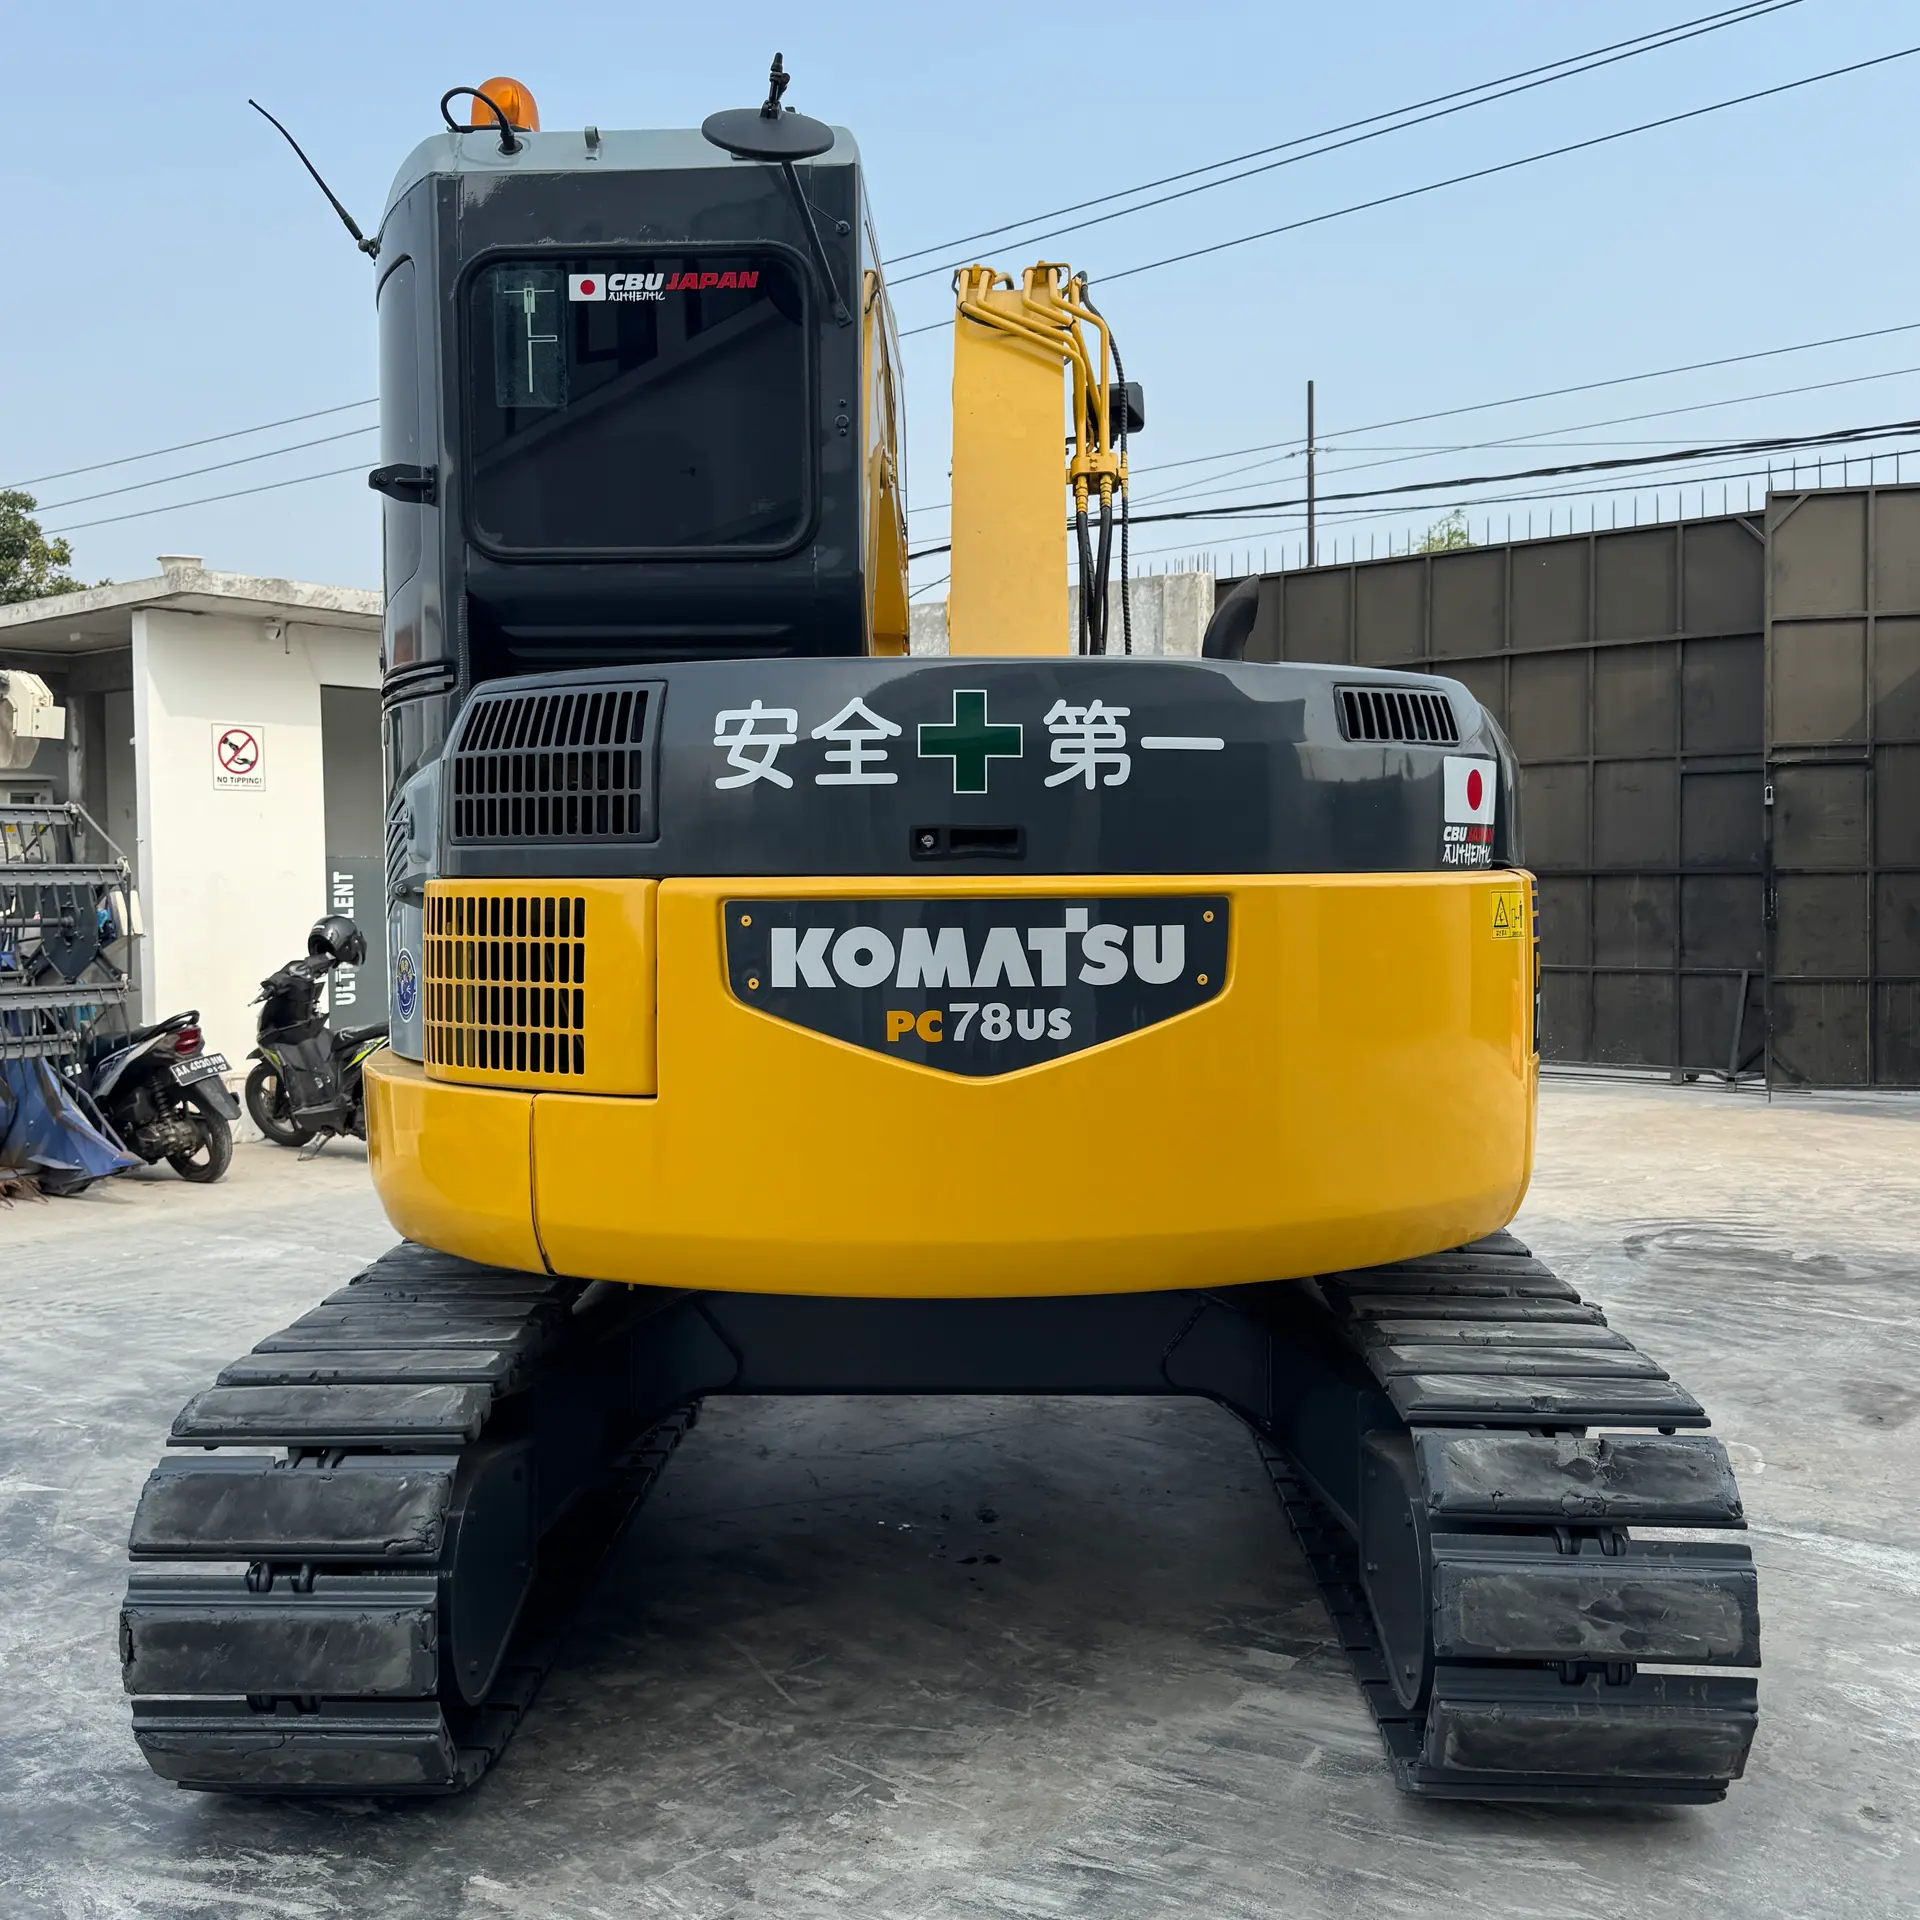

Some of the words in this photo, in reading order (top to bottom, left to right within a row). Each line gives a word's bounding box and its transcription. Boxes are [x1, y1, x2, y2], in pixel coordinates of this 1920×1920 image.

[608, 273, 665, 290] CBU
[665, 271, 759, 290] JAPAN
[607, 291, 666, 302] AUTHENTIC
[714, 697, 903, 790] 安全
[1043, 699, 1225, 790] 第一
[1443, 825, 1468, 842] CBU
[771, 907, 1186, 988] KOMATSU
